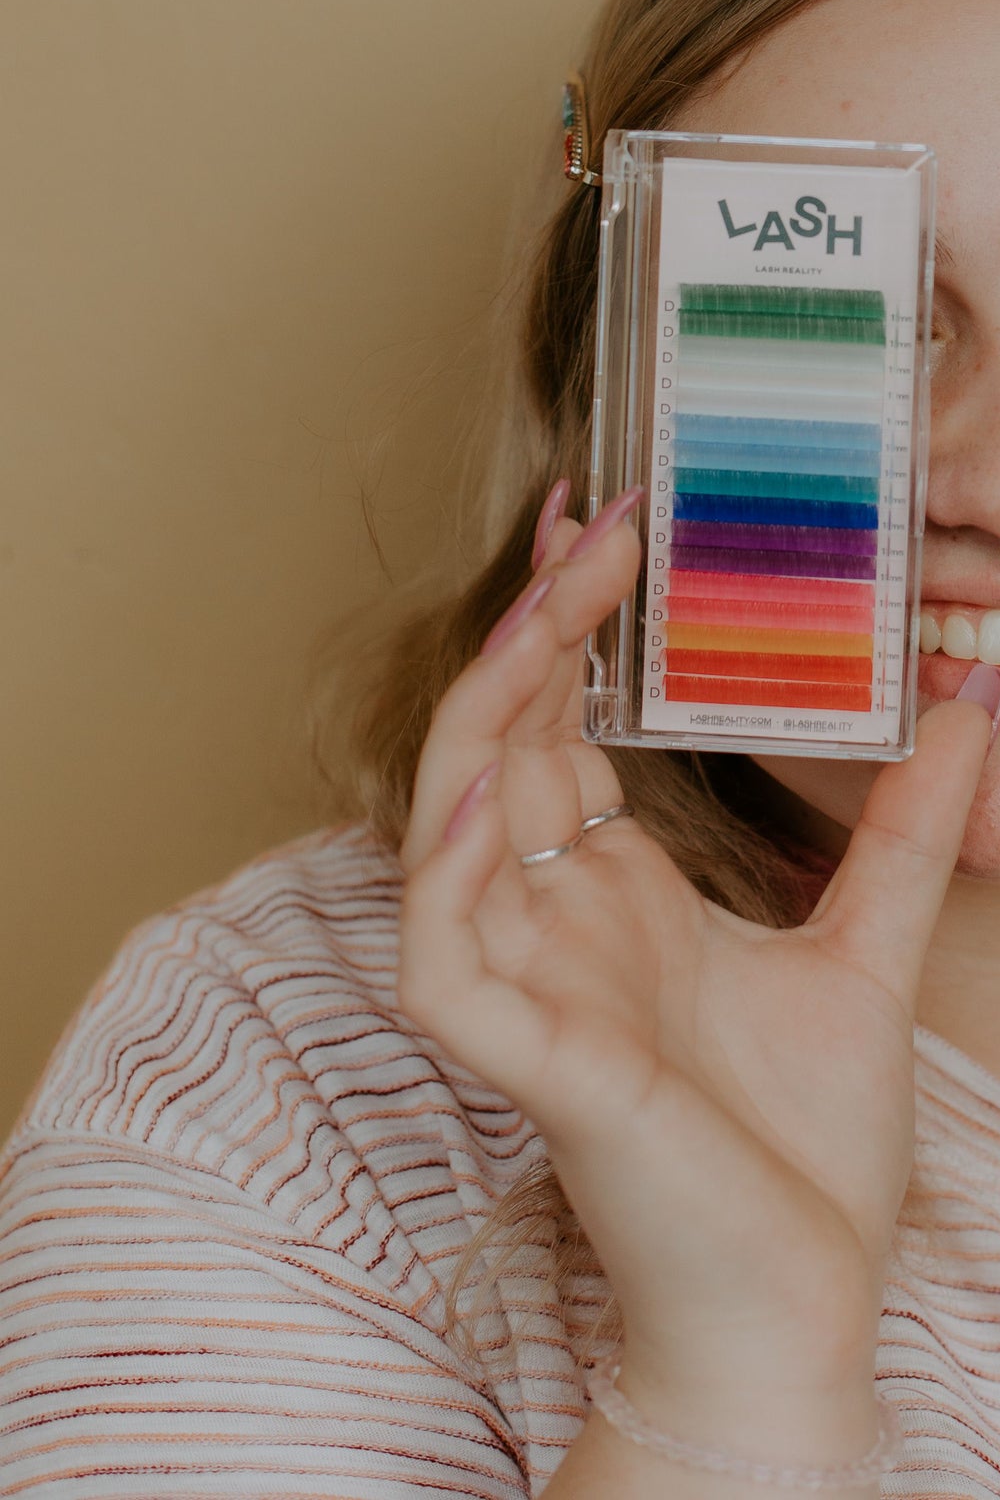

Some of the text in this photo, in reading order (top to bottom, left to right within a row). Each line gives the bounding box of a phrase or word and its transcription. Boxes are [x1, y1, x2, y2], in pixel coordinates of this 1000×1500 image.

[717, 195, 862, 256] LASH
[755, 265, 823, 276] LASH REALITY
[665, 301, 674, 311] D
[664, 326, 673, 337] D
[663, 352, 672, 362] D
[662, 378, 671, 388] D
[661, 404, 670, 414] D
[660, 430, 669, 440] D
[659, 455, 668, 466] D
[658, 481, 667, 491] D
[657, 507, 667, 517] D
[656, 533, 666, 543] D
[655, 559, 664, 569] D
[654, 584, 664, 594] D
[653, 610, 663, 620] D
[652, 636, 662, 646] D
[651, 662, 661, 672] D
[650, 687, 660, 697] D
